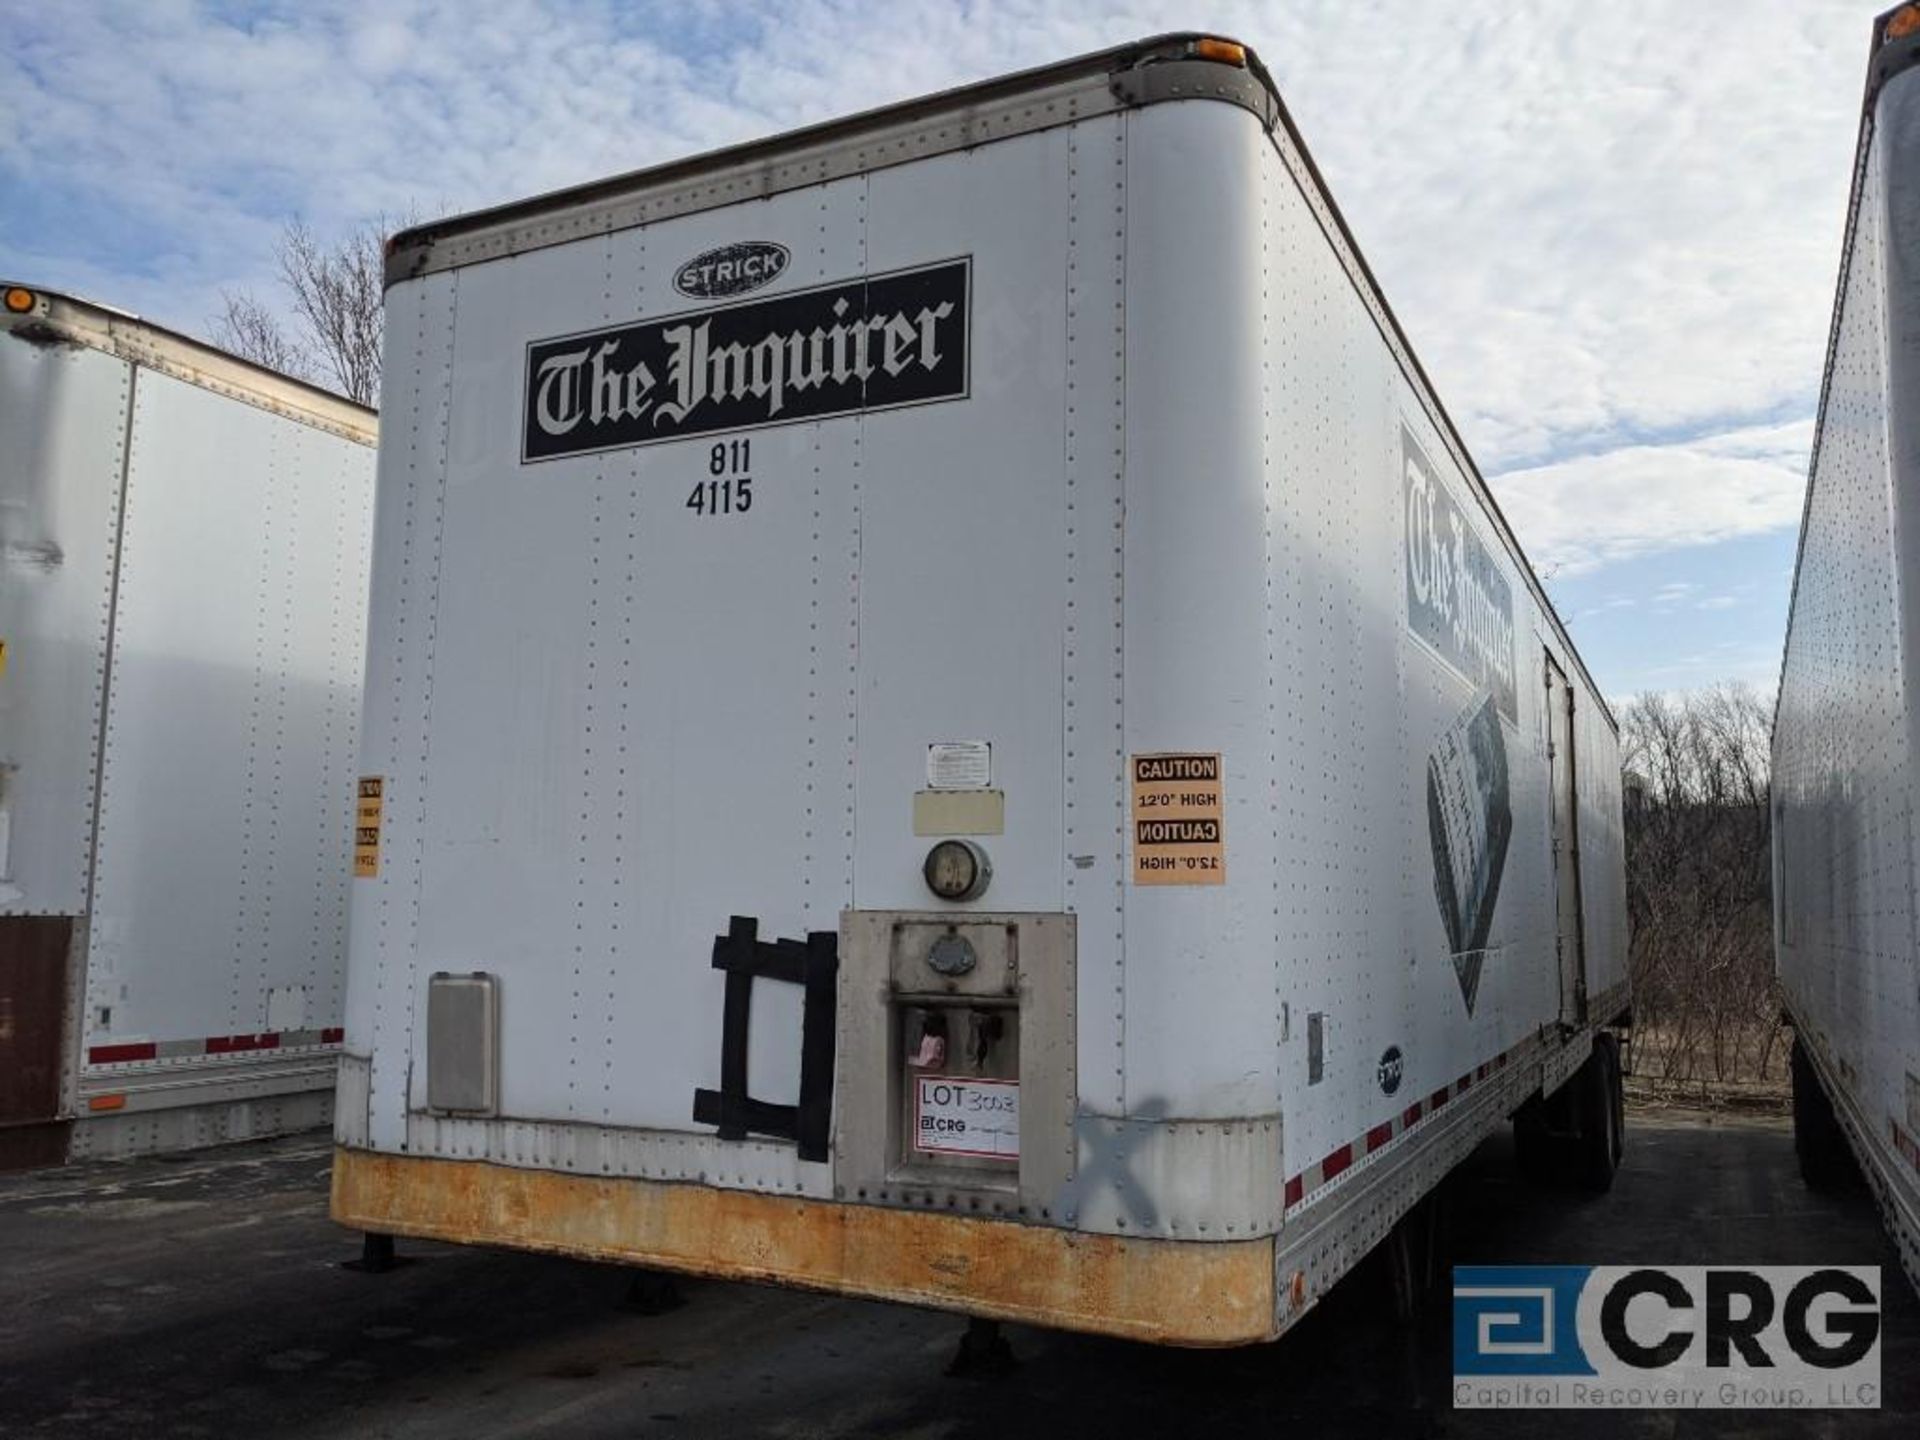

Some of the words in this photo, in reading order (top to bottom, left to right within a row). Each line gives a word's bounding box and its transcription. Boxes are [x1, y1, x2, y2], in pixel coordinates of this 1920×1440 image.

[681, 250, 781, 288] STRICK
[536, 338, 657, 436] The
[652, 296, 956, 429] Inquirer
[709, 438, 751, 476] 811
[686, 478, 752, 516] 4115
[1406, 457, 1453, 626] The
[1138, 759, 1216, 779] CAUTION
[1180, 793, 1217, 807] HIGH
[922, 1083, 966, 1107] LOT
[936, 1119, 966, 1132] CRG
